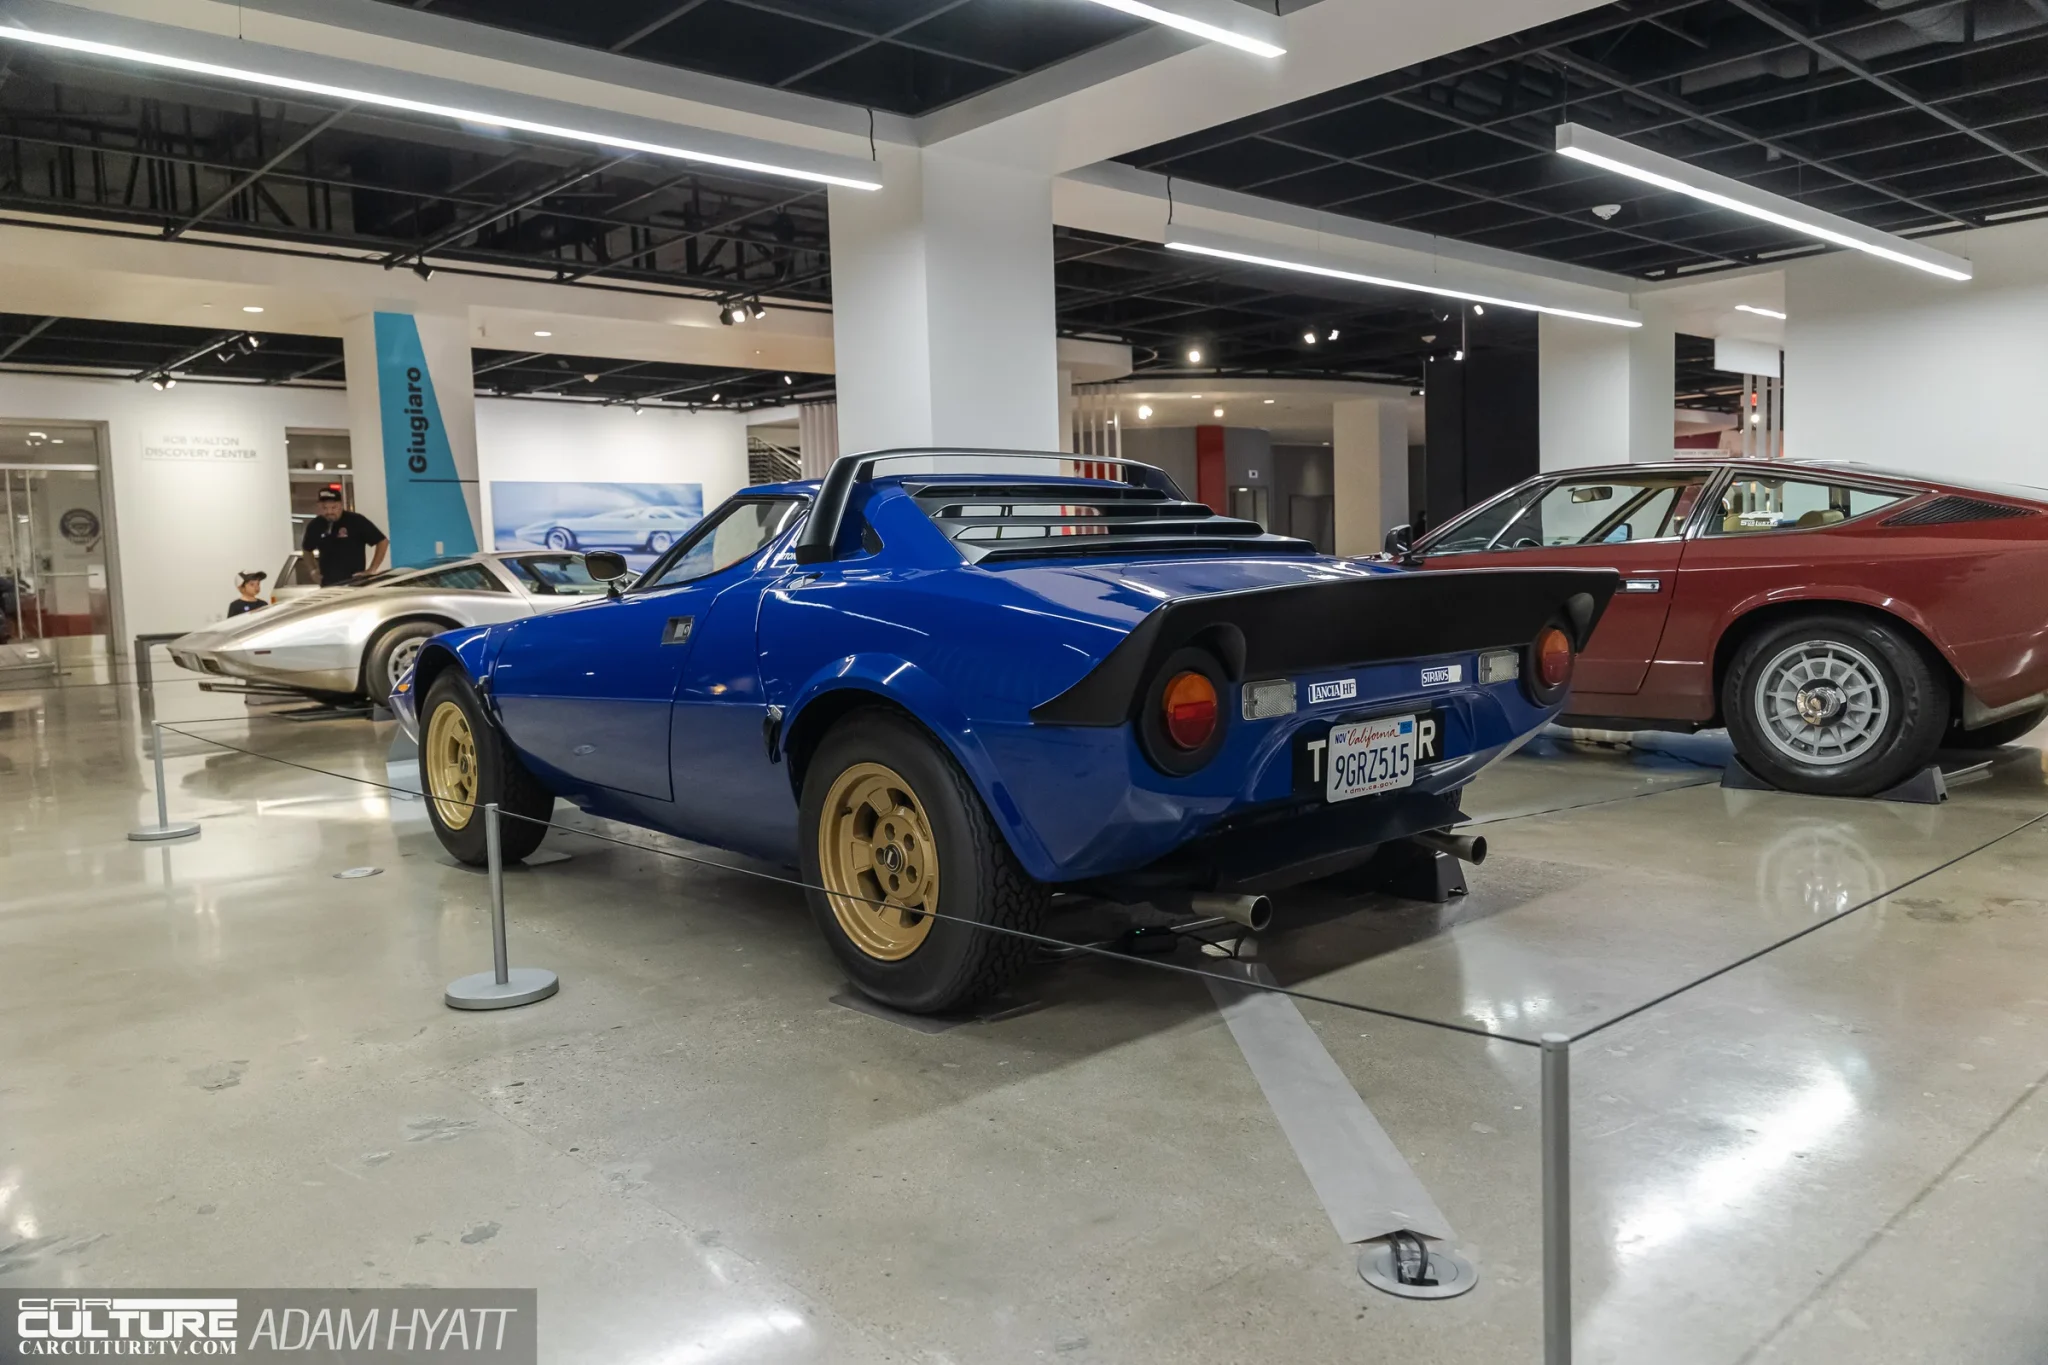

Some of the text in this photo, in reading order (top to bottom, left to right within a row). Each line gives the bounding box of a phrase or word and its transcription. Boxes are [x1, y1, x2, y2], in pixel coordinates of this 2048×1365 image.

[404, 367, 429, 474] Giugiaro
[192, 436, 240, 446] WALTON
[145, 446, 257, 459] DISCOVERY CENTER
[1422, 670, 1448, 683] STRATOS
[1310, 682, 1355, 702] LANCIA HF
[1335, 732, 1347, 744] NOV
[1347, 726, 1400, 748] California
[1334, 743, 1410, 790] 9GRZ515
[1349, 780, 1394, 795] dmv.ca.gov
